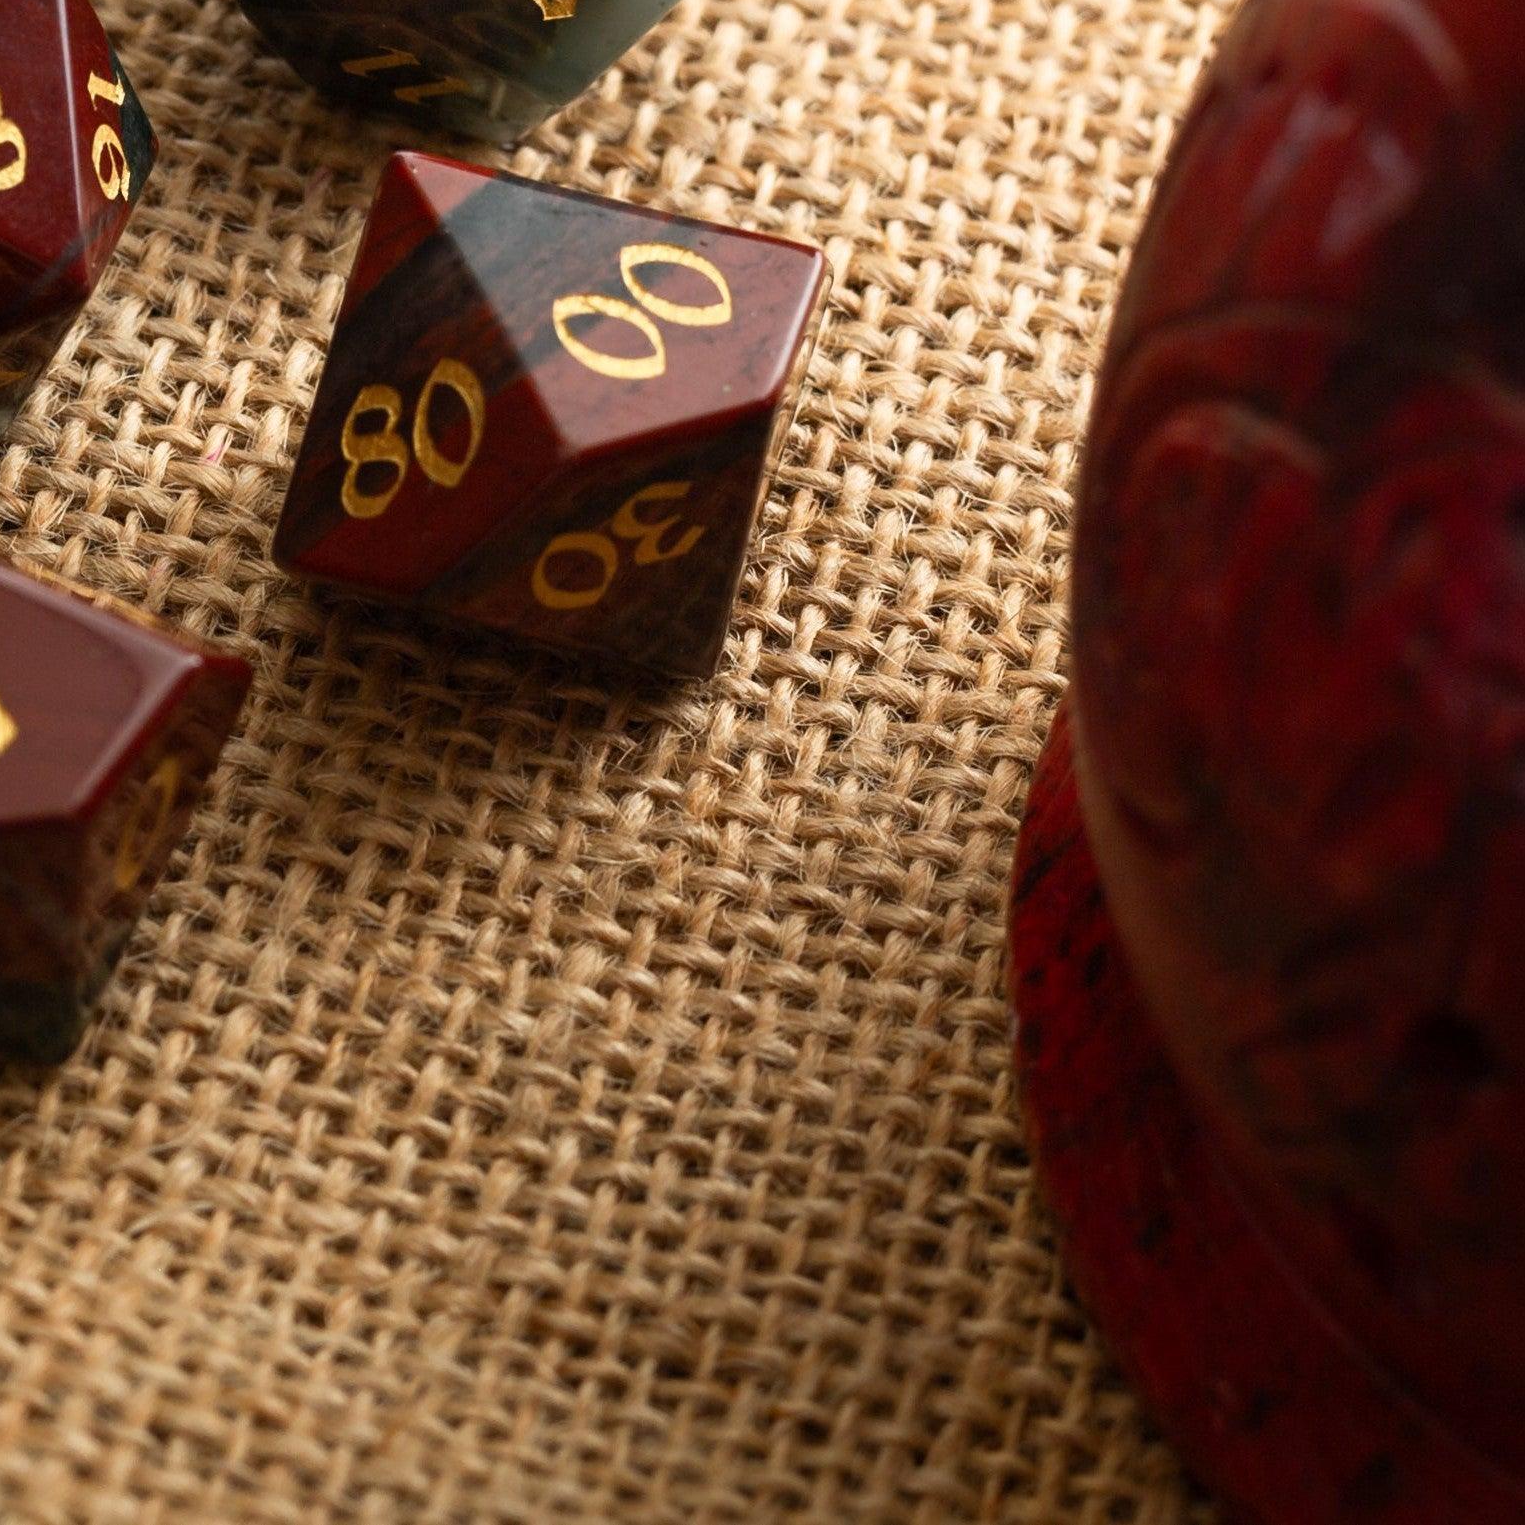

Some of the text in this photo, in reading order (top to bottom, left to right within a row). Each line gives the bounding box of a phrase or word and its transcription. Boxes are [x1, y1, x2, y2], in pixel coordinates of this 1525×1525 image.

[552, 242, 732, 379] 00
[341, 357, 485, 519] 80
[531, 481, 705, 609] 30
